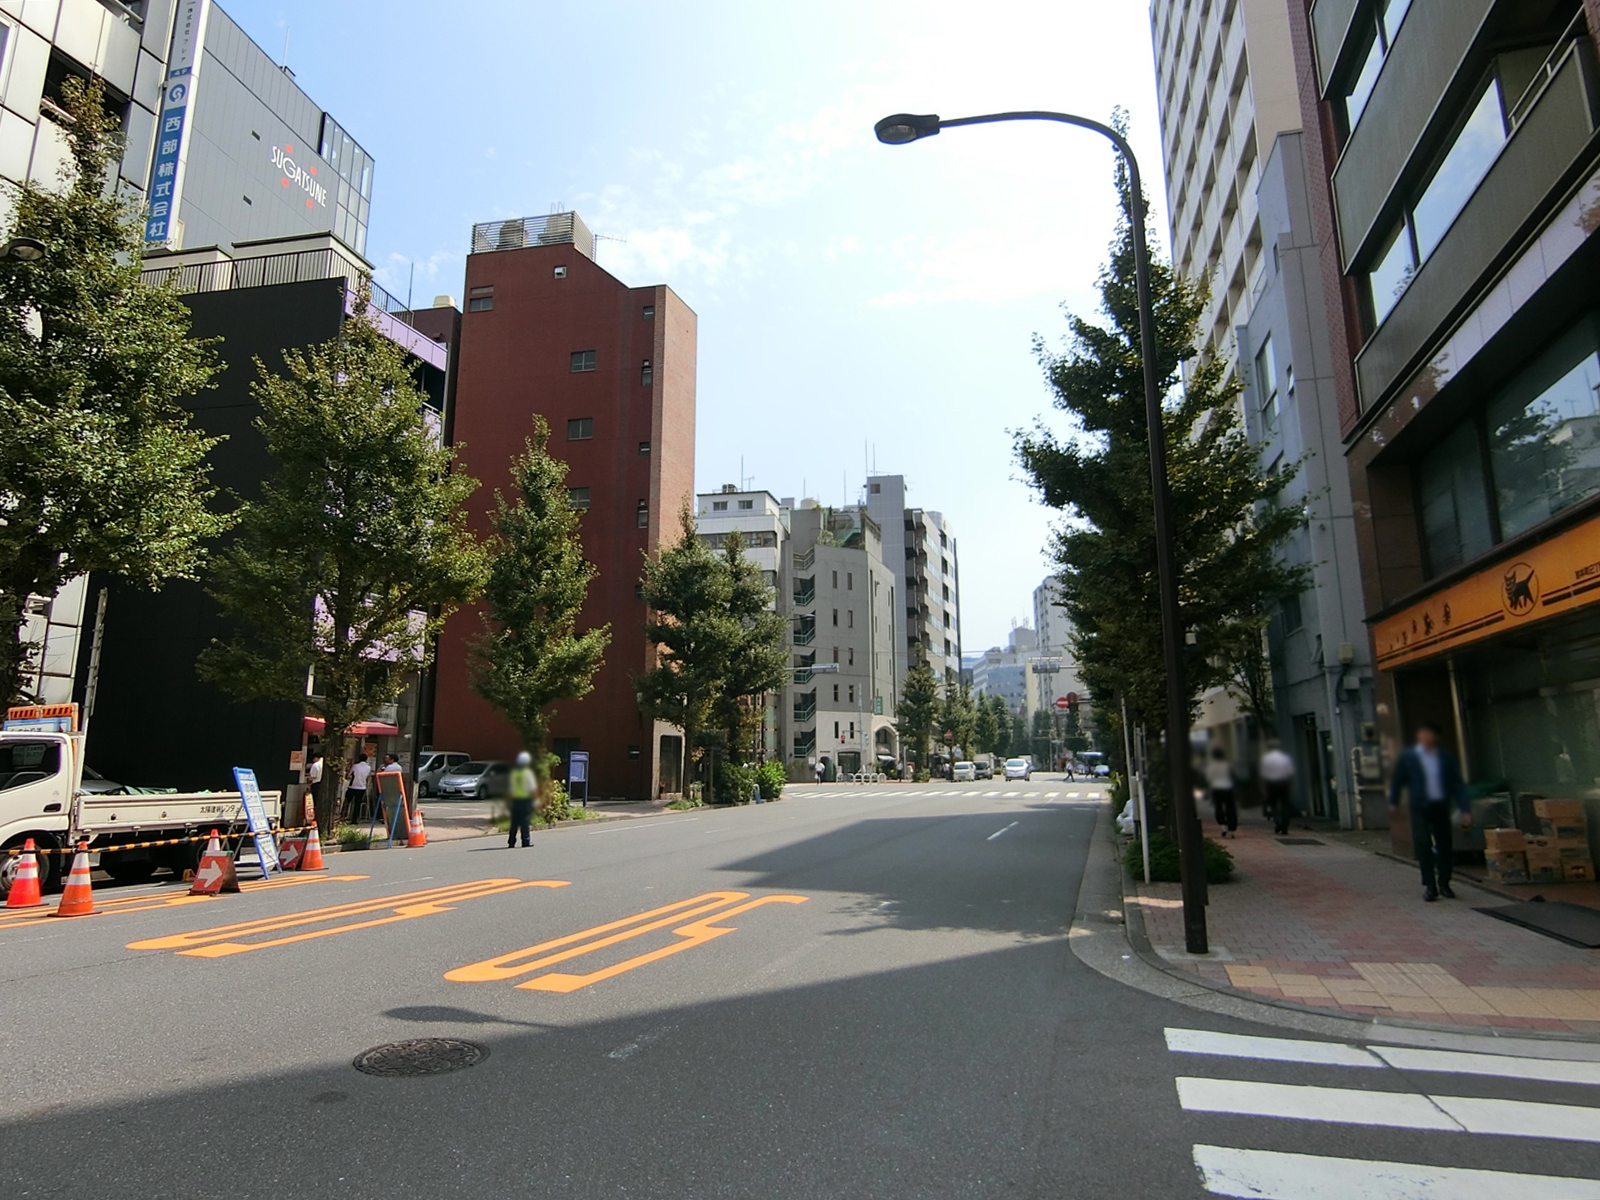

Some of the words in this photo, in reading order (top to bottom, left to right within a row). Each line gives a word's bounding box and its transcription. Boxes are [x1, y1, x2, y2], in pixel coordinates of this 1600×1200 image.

[149, 116, 181, 237] 西部株式会社
[271, 146, 327, 207] SUGATSUNE
